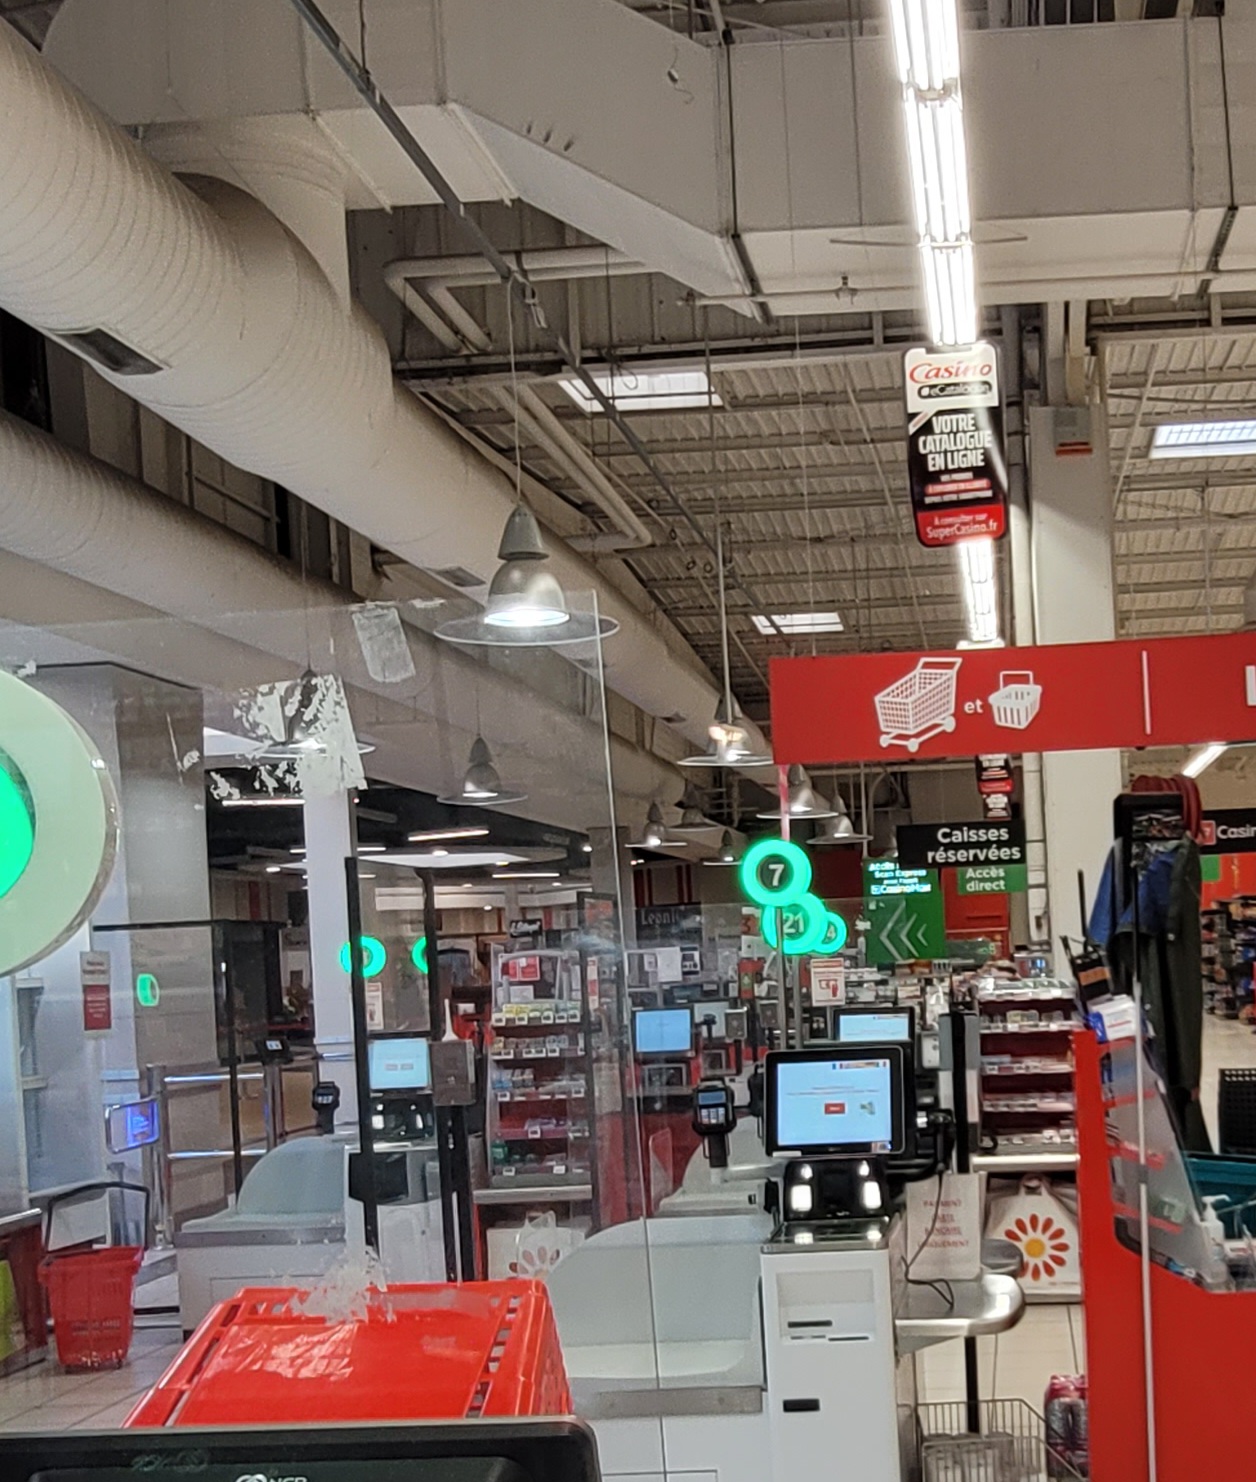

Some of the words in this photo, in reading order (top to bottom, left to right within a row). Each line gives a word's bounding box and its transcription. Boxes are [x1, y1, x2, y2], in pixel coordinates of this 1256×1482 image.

[932, 414, 976, 433] VOTRE
[918, 430, 993, 454] CATALOGUE
[927, 452, 945, 472] EN
[946, 449, 985, 470] LIGNE
[964, 698, 983, 714] et
[937, 826, 1009, 843] Caisses
[927, 844, 1021, 863] réservées
[768, 864, 785, 886] 7
[966, 866, 1005, 879] Accès
[965, 880, 1006, 892] direct
[783, 912, 805, 934] 21
